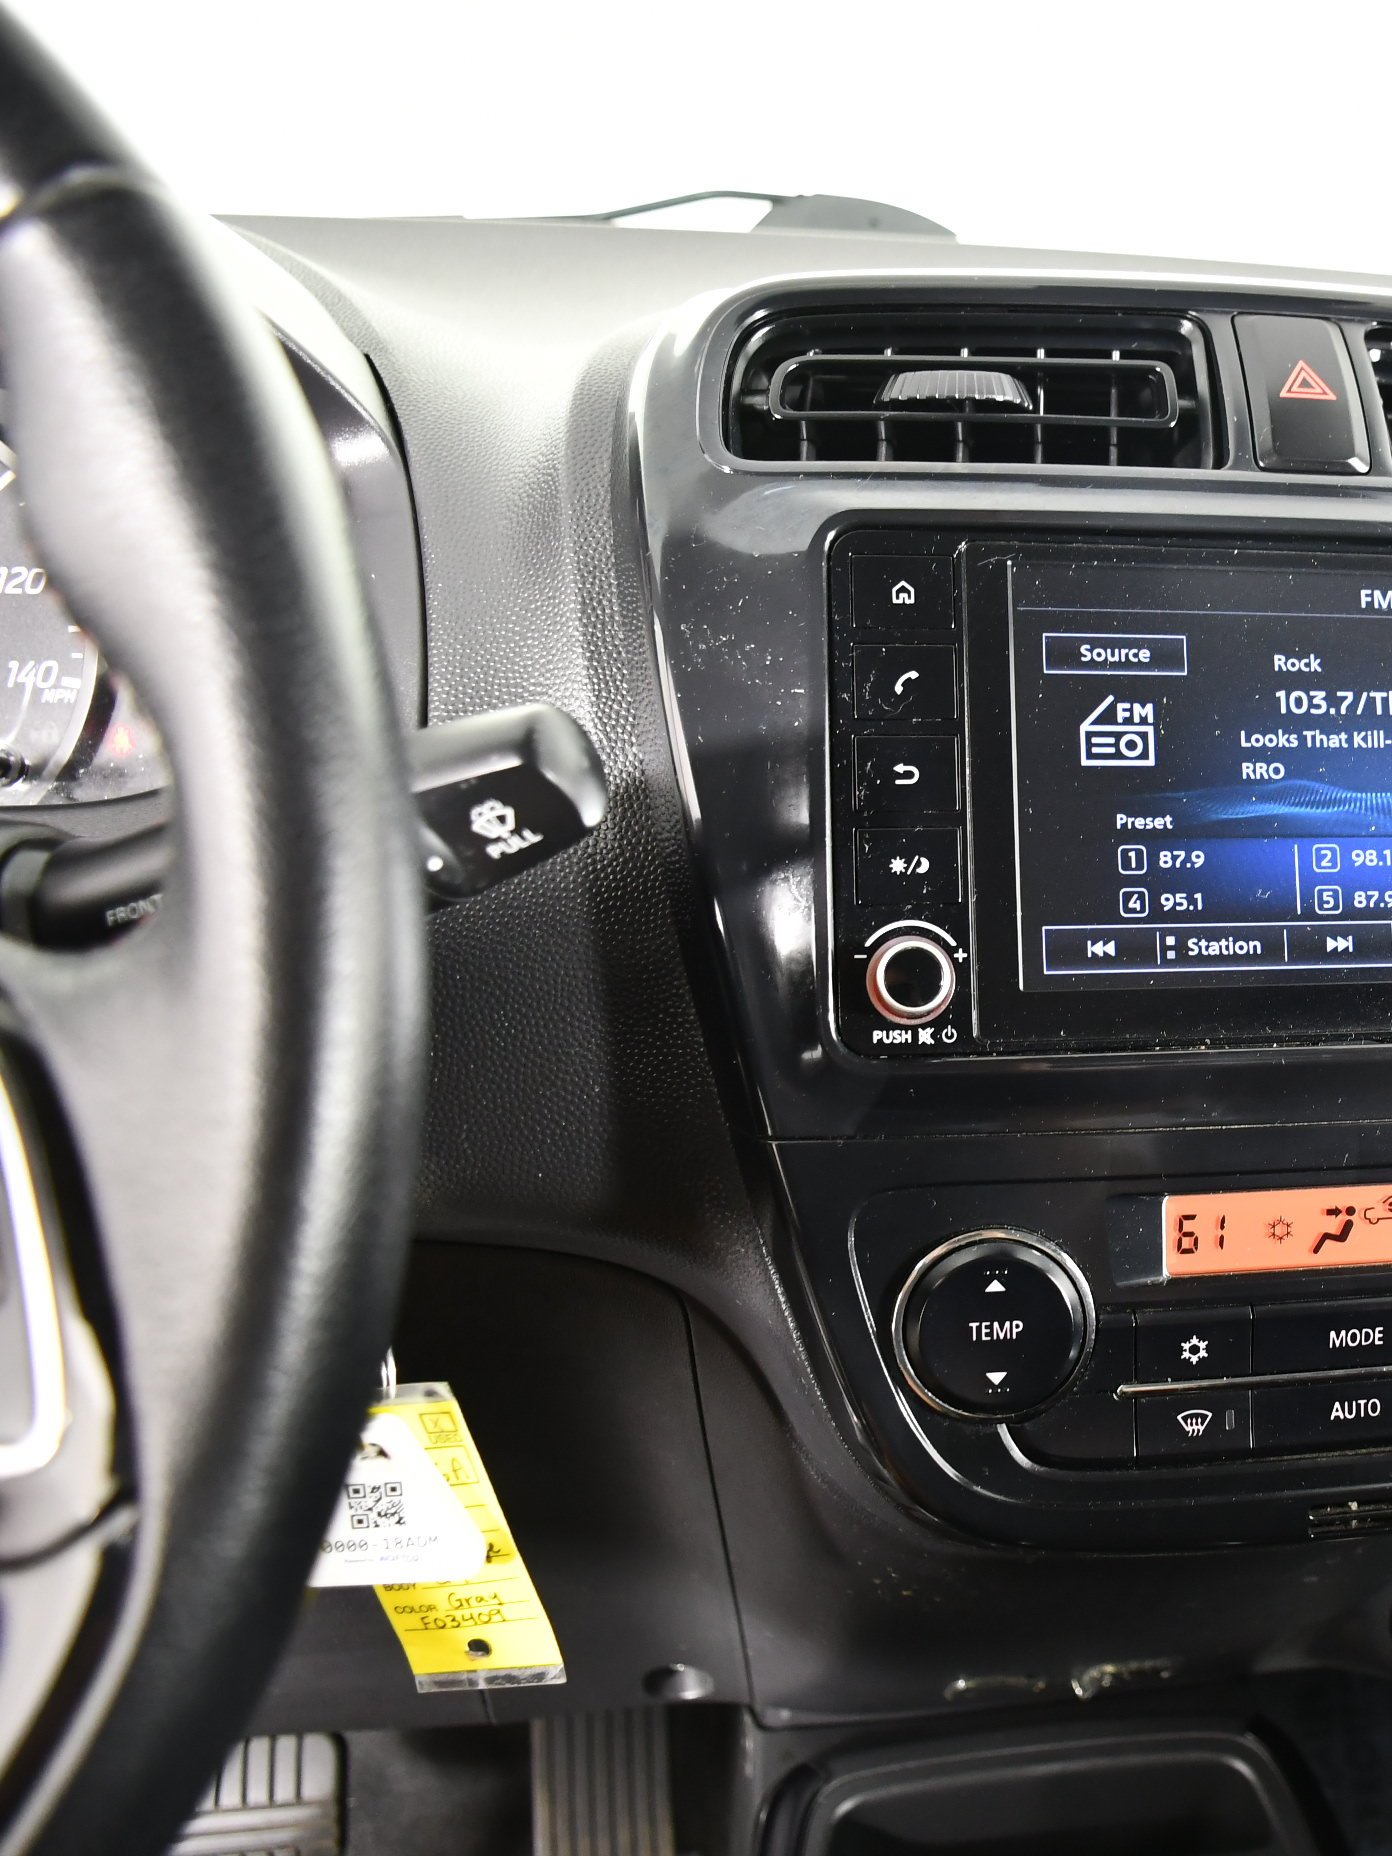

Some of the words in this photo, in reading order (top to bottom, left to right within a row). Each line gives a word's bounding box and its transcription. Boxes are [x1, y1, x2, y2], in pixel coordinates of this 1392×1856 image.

[1079, 644, 1151, 665] Source
[1273, 653, 1322, 673] Rock
[7, 660, 58, 689] 140
[41, 689, 77, 704] MPH
[1116, 702, 1154, 724] FM
[1240, 728, 1299, 748] Looks
[1302, 729, 1349, 748] That
[1241, 762, 1286, 780] RRO
[1116, 813, 1174, 830] Preset
[486, 827, 544, 860] PULL
[1128, 852, 1138, 869] 1
[1159, 850, 1205, 869] 87.9
[1319, 850, 1333, 867] 2
[1351, 849, 1392, 867] 98.1
[1127, 894, 1142, 910] 4
[1160, 892, 1203, 912] 95.1
[1322, 892, 1335, 908] 5
[1187, 936, 1262, 956] Station
[872, 1029, 912, 1044] PUSH
[1177, 1214, 1226, 1254] 61
[968, 1320, 1024, 1342] TEMP
[1329, 1326, 1384, 1349] MODE
[1330, 1398, 1381, 1421] AUTO
[382, 1582, 416, 1592] BODY
[394, 1604, 438, 1614] COLOR
[448, 1592, 504, 1610] Gray
